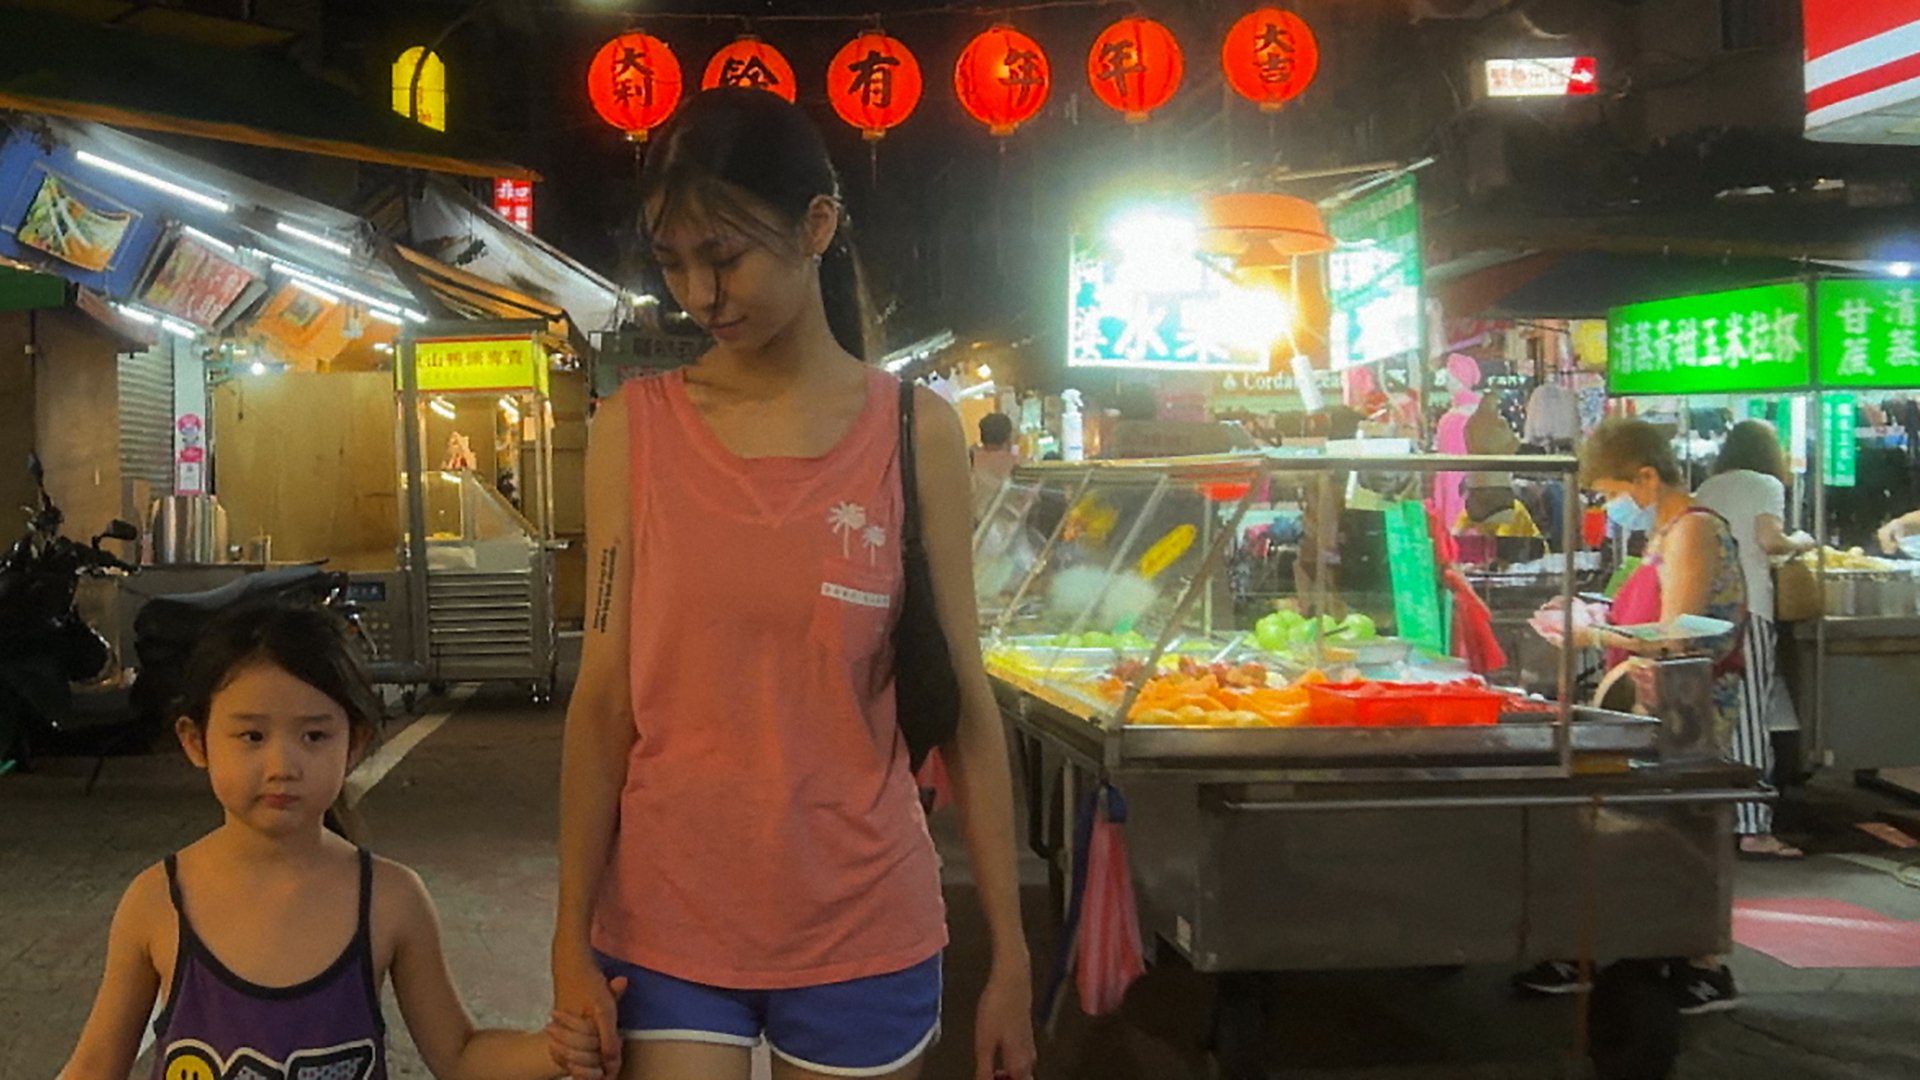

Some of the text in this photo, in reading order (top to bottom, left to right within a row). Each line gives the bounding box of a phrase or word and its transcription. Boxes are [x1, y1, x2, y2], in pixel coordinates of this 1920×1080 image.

[613, 47, 654, 108] 大利
[848, 50, 902, 108] 有
[1096, 39, 1147, 97] 年
[1254, 23, 1296, 83] 大吉
